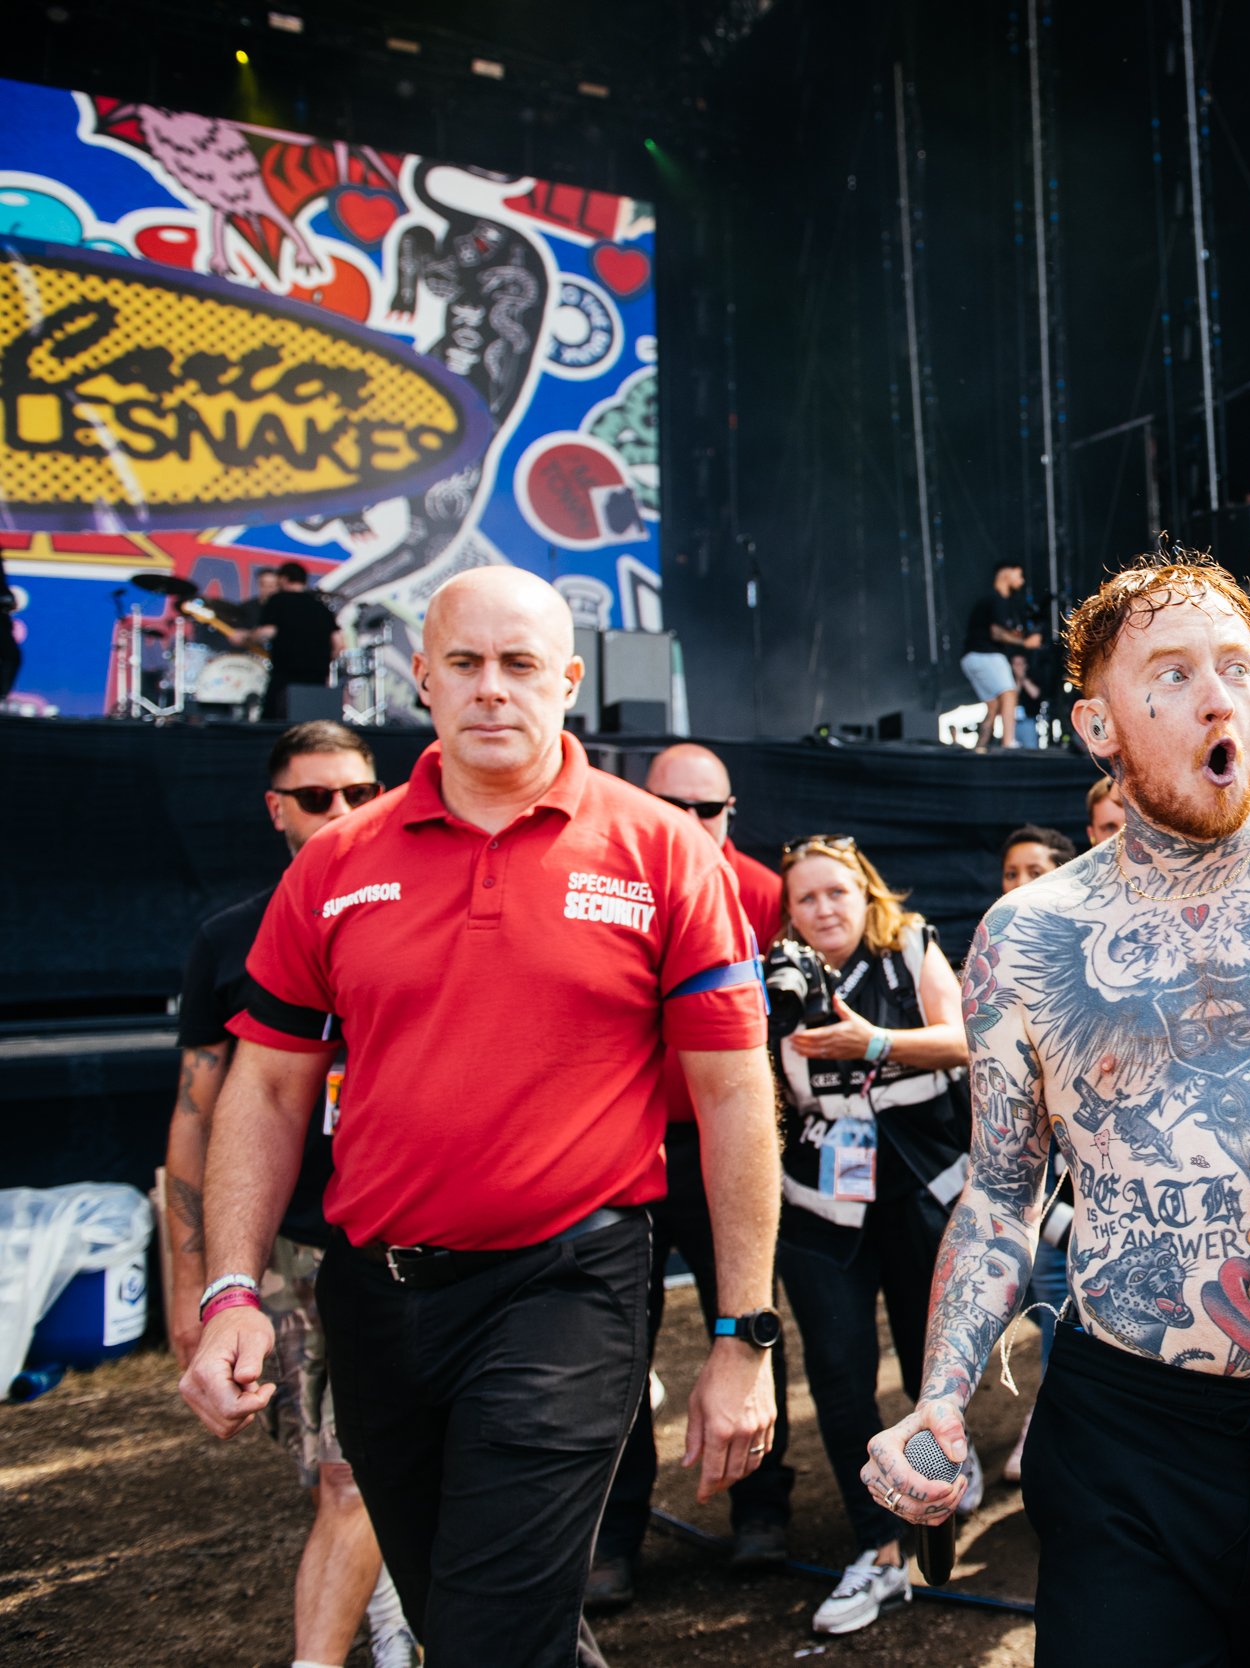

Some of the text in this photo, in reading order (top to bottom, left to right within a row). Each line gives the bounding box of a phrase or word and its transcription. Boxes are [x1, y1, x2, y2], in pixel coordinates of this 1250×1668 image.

[563, 890, 657, 933] SECURITY
[1092, 1220, 1119, 1240] THE
[1120, 1228, 1245, 1260] ANSWER
